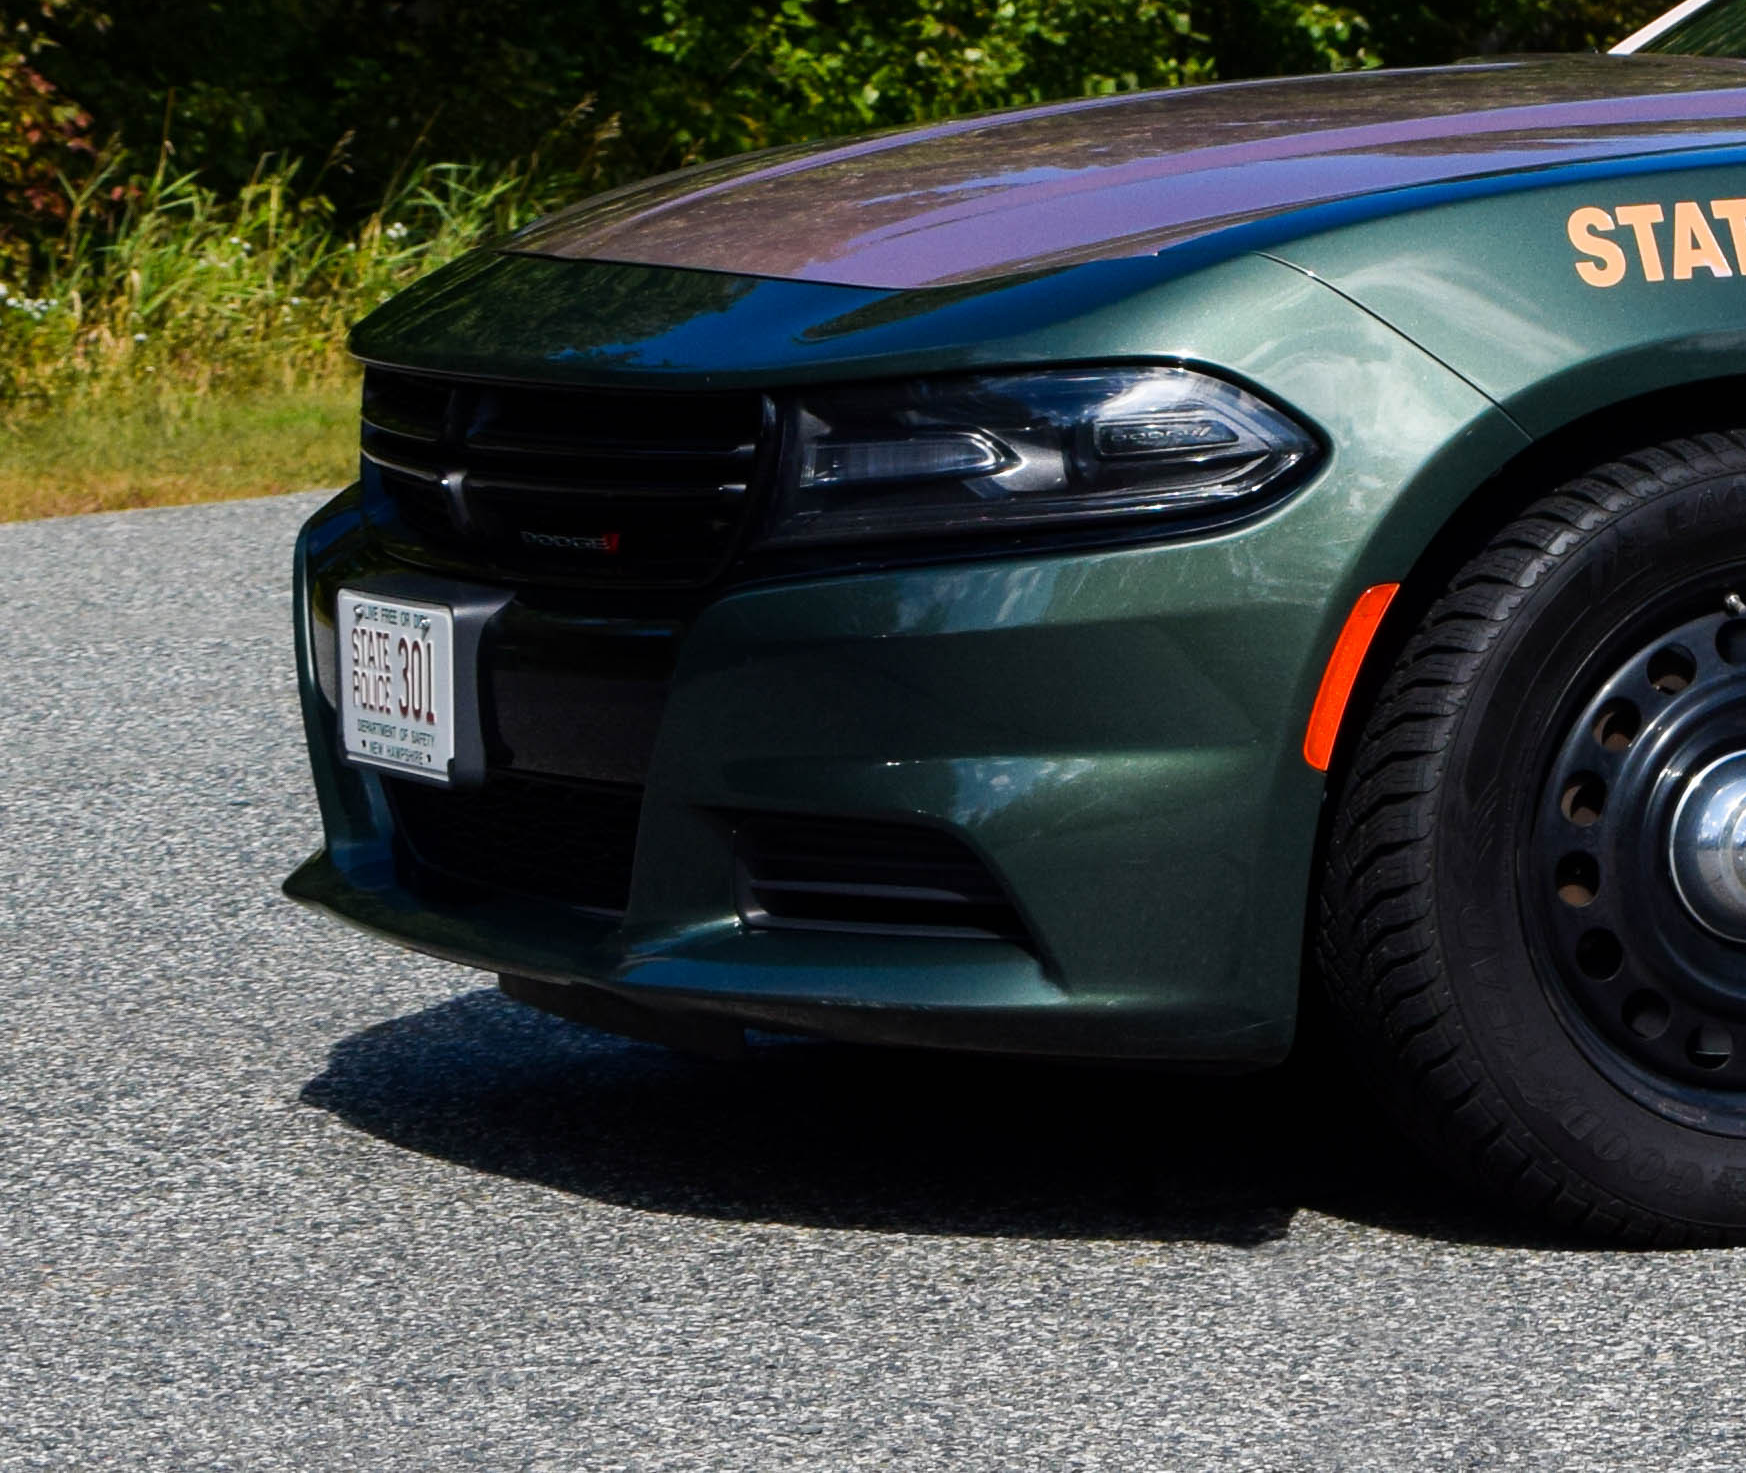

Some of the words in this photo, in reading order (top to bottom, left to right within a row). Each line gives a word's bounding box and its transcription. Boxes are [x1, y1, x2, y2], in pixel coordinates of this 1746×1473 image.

[381, 607, 398, 626] FREE
[351, 627, 391, 671] STATE
[397, 636, 436, 726] 301
[352, 670, 391, 715] POLICE
[357, 718, 397, 739] DEPARTMENT
[400, 728, 409, 741] OF
[411, 730, 435, 749] SAFETY
